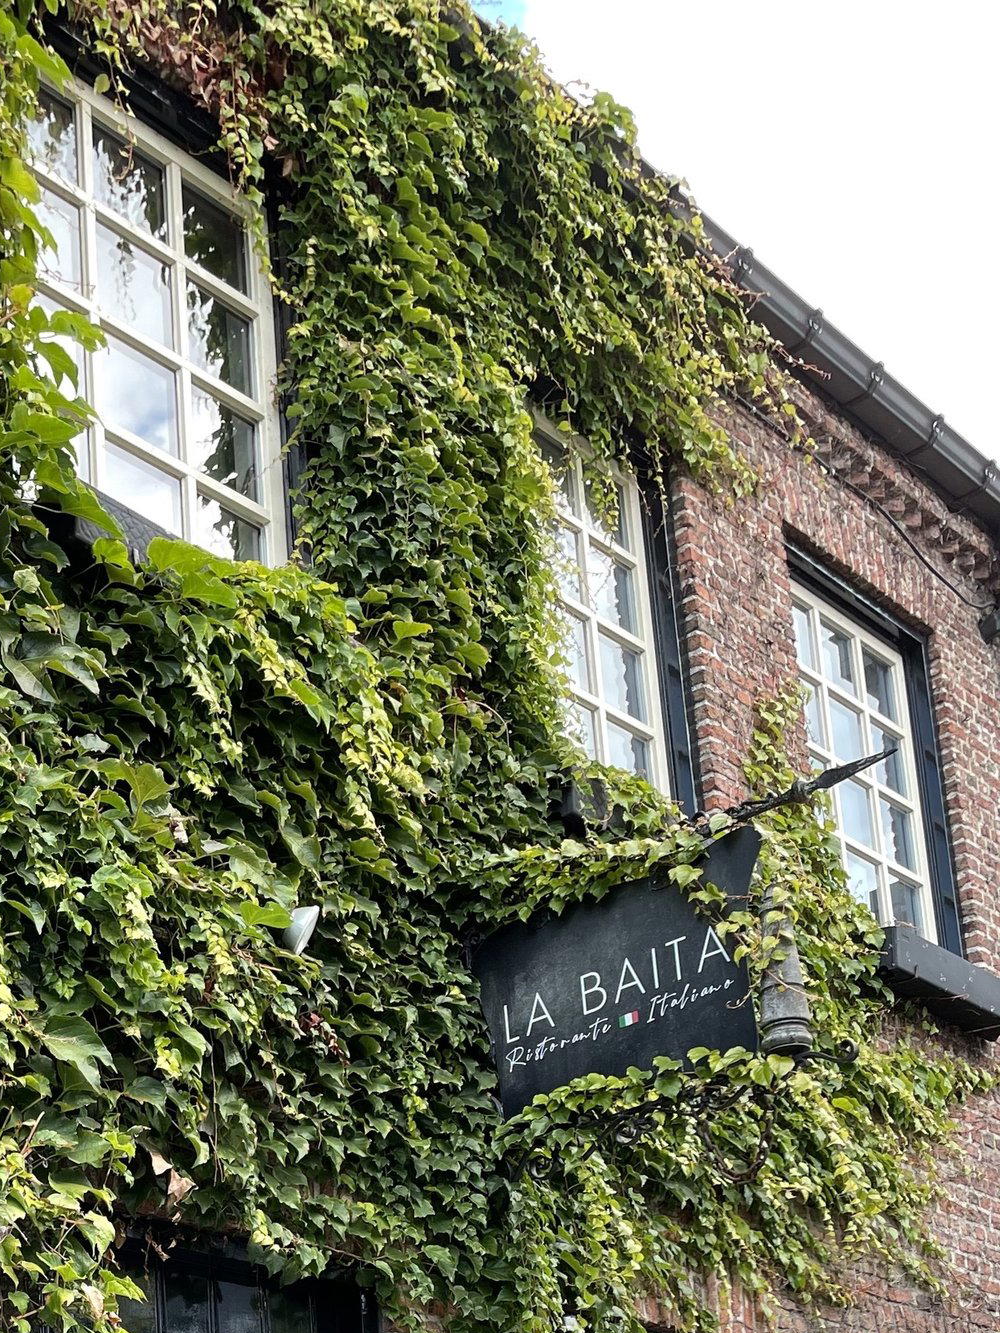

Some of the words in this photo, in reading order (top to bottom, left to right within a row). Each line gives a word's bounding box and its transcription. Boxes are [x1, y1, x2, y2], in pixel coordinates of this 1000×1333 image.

[503, 992, 556, 1044] LA
[580, 925, 731, 1016] BAITA
[505, 1016, 612, 1074] Ristorante
[646, 977, 735, 1025] Italiano
